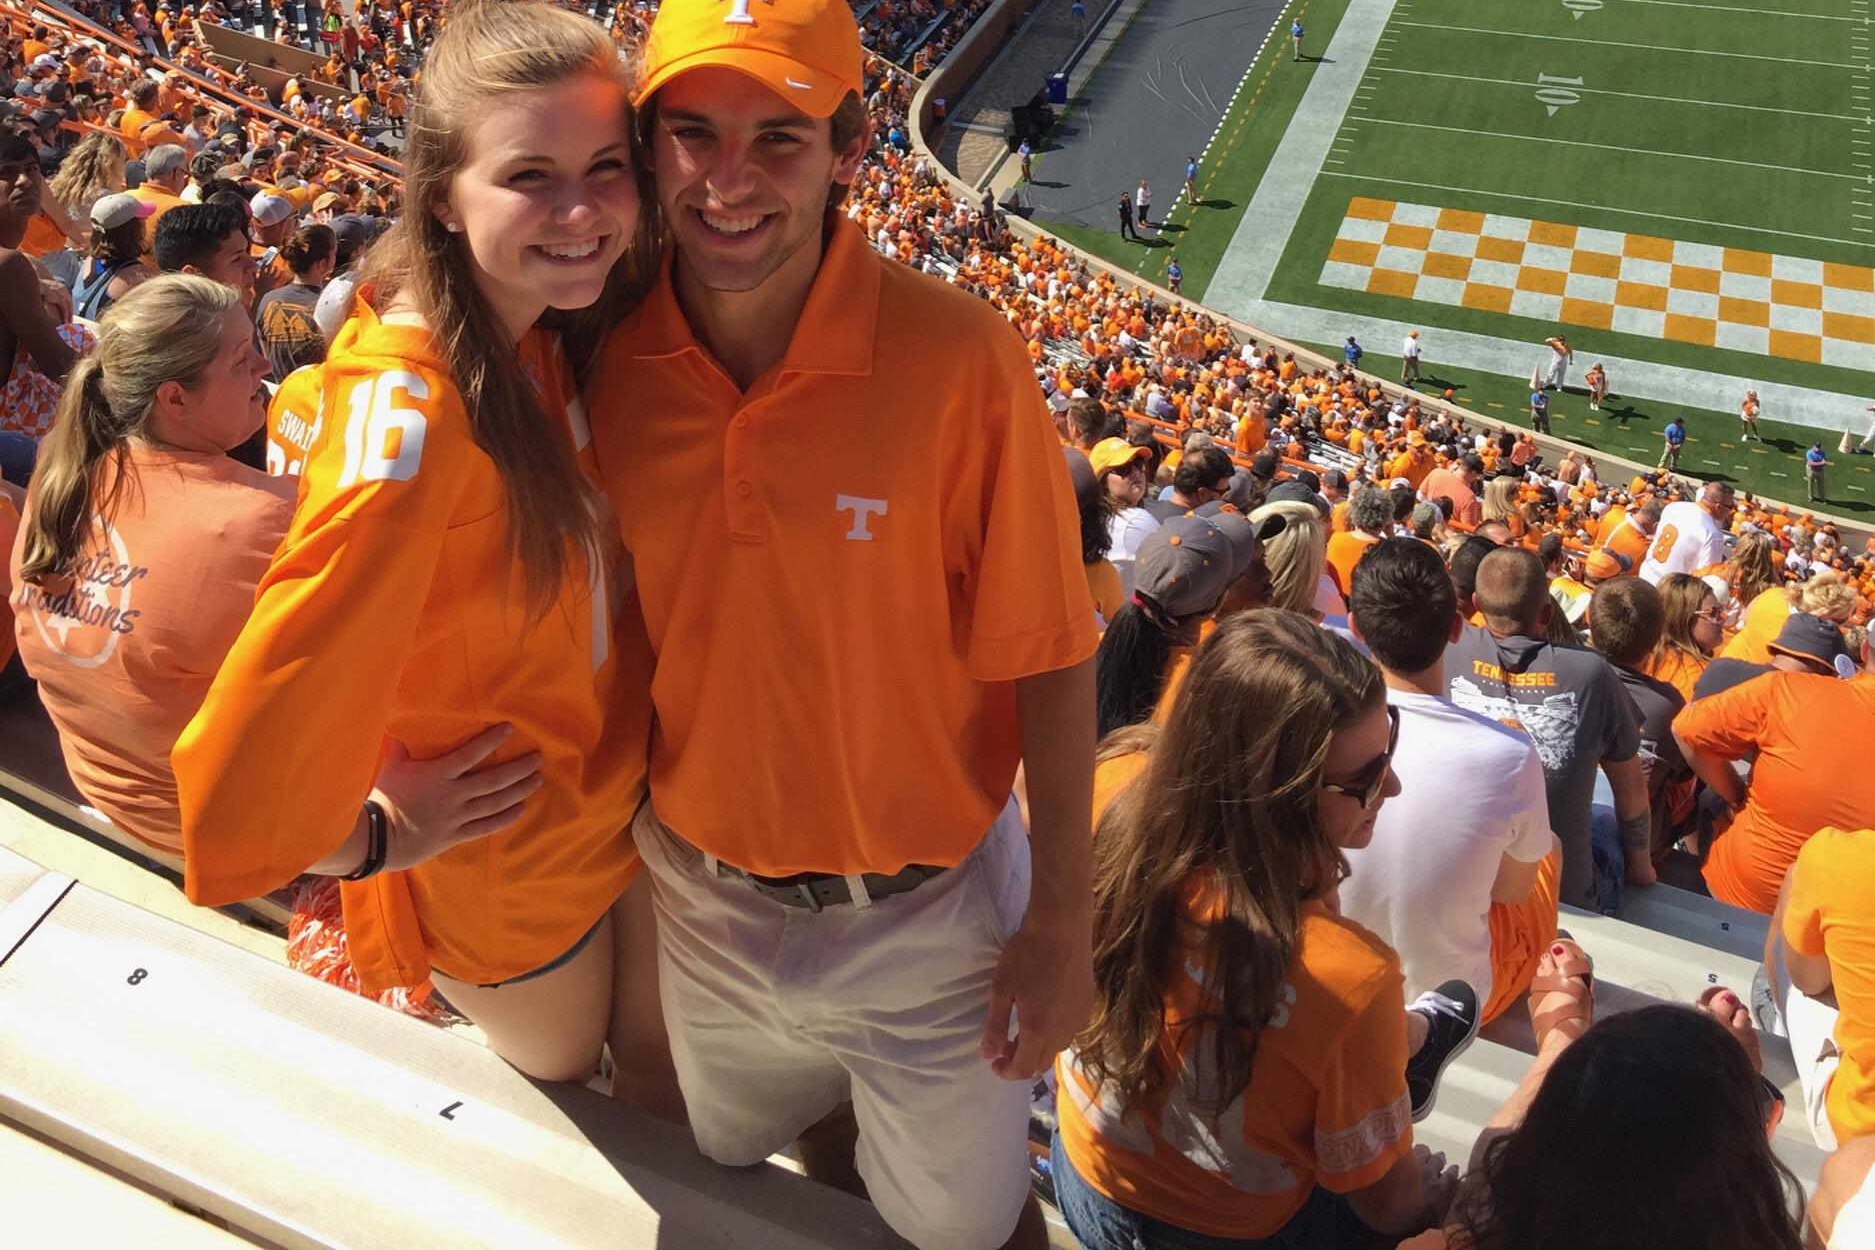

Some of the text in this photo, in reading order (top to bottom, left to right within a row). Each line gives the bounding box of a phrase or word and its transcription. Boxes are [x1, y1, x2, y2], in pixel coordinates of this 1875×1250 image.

[1534, 72, 1584, 105] 10
[337, 370, 429, 488] 16
[836, 494, 888, 540] T
[1652, 523, 1679, 563] 8
[127, 968, 148, 986] 8
